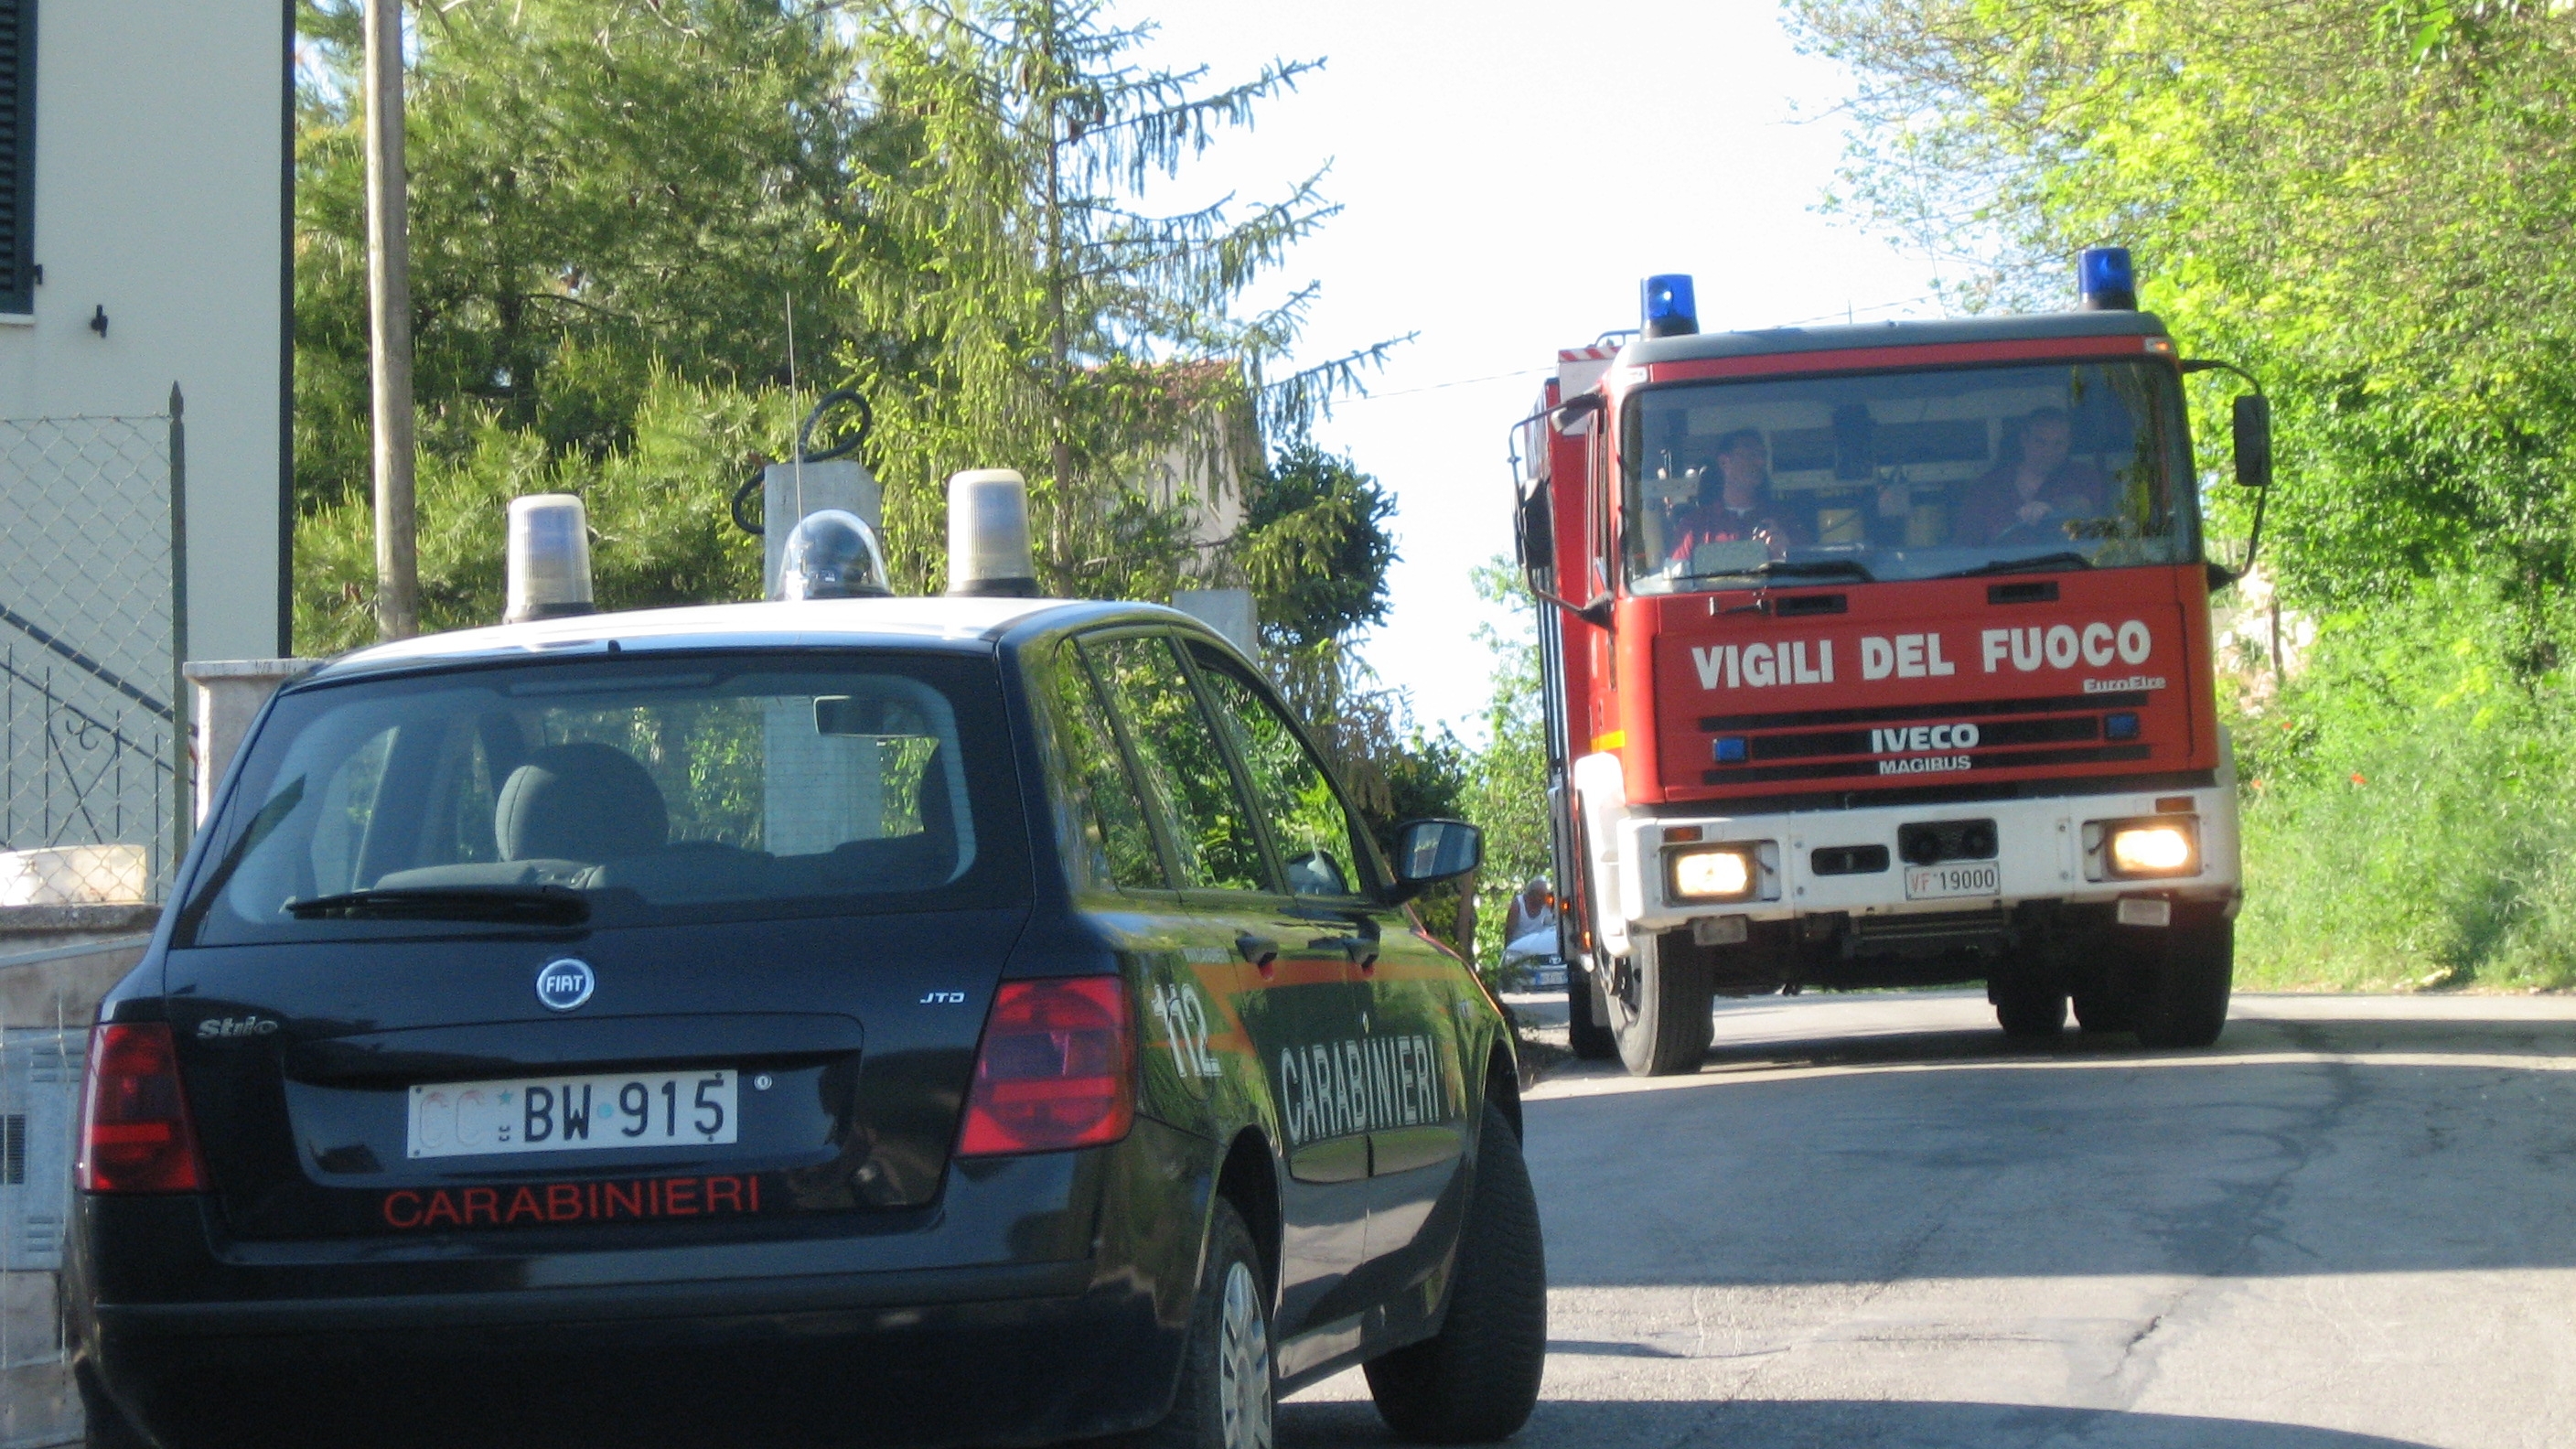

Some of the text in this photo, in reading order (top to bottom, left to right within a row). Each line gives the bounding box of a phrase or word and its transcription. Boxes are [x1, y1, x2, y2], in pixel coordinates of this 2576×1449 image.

[1691, 619, 2152, 691] VIGILI DEL FUOCO
[1872, 723, 1980, 754] IVECO
[1911, 869, 1995, 893] VF 19000
[545, 974, 585, 993] FIAT
[918, 992, 965, 1004] JTD
[197, 1015, 278, 1039] Stilo
[1151, 982, 1224, 1079] 112
[1282, 1035, 1441, 1144] CARABINIERI
[523, 1084, 592, 1143] BW
[618, 1079, 725, 1138] 915
[384, 1176, 759, 1227] CARABINIERI
